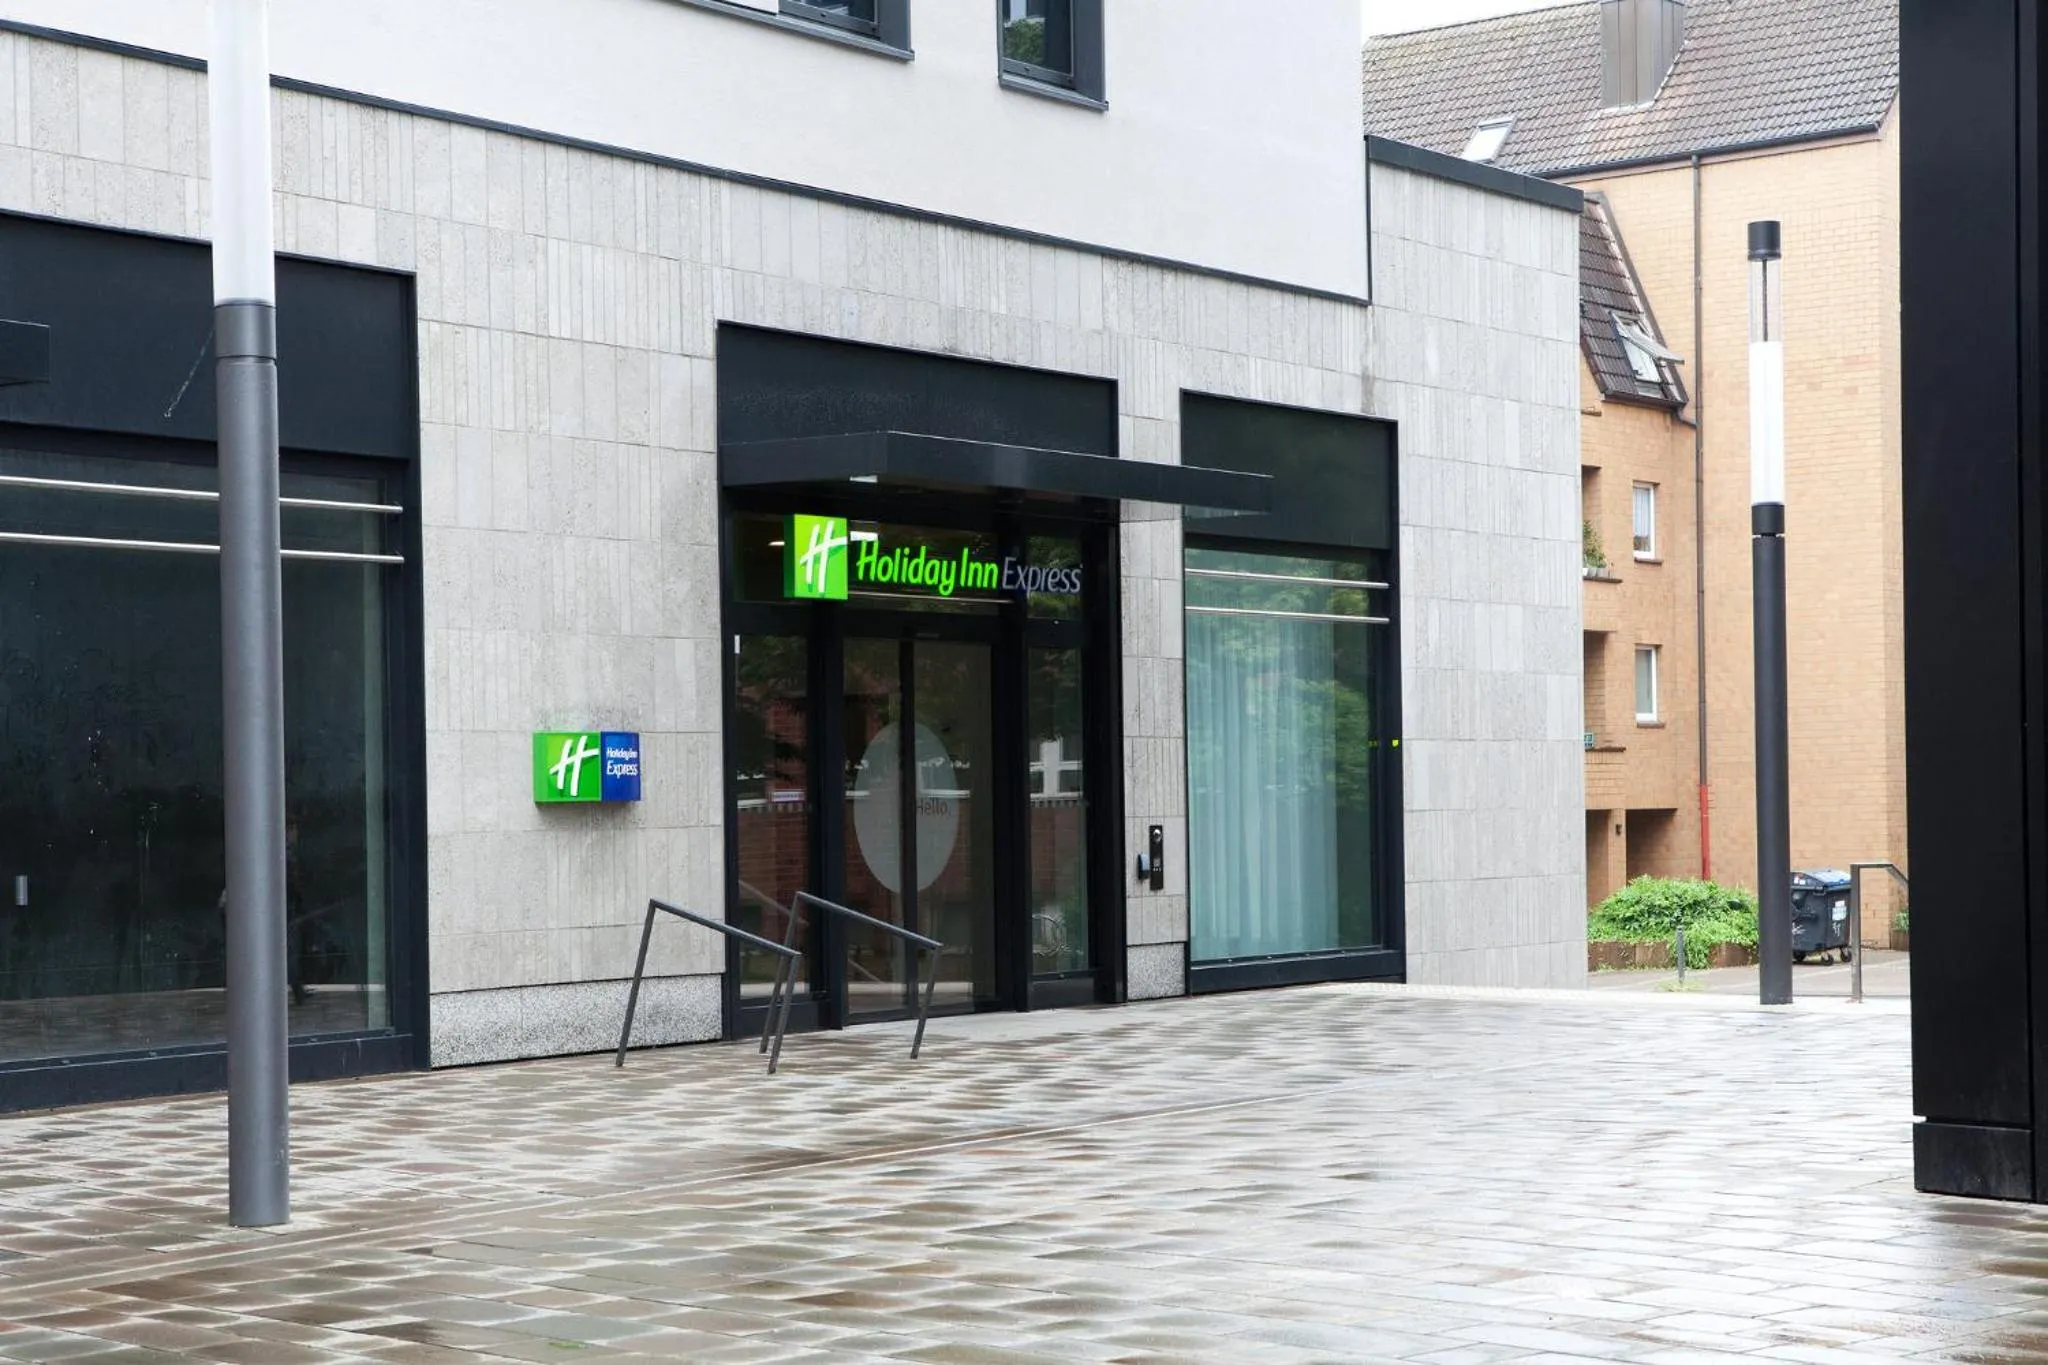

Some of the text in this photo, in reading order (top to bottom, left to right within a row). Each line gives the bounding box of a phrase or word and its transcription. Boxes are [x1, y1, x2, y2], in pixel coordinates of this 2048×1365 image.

[856, 539, 1082, 599] Holiday Inn Express
[606, 760, 639, 779] Express
